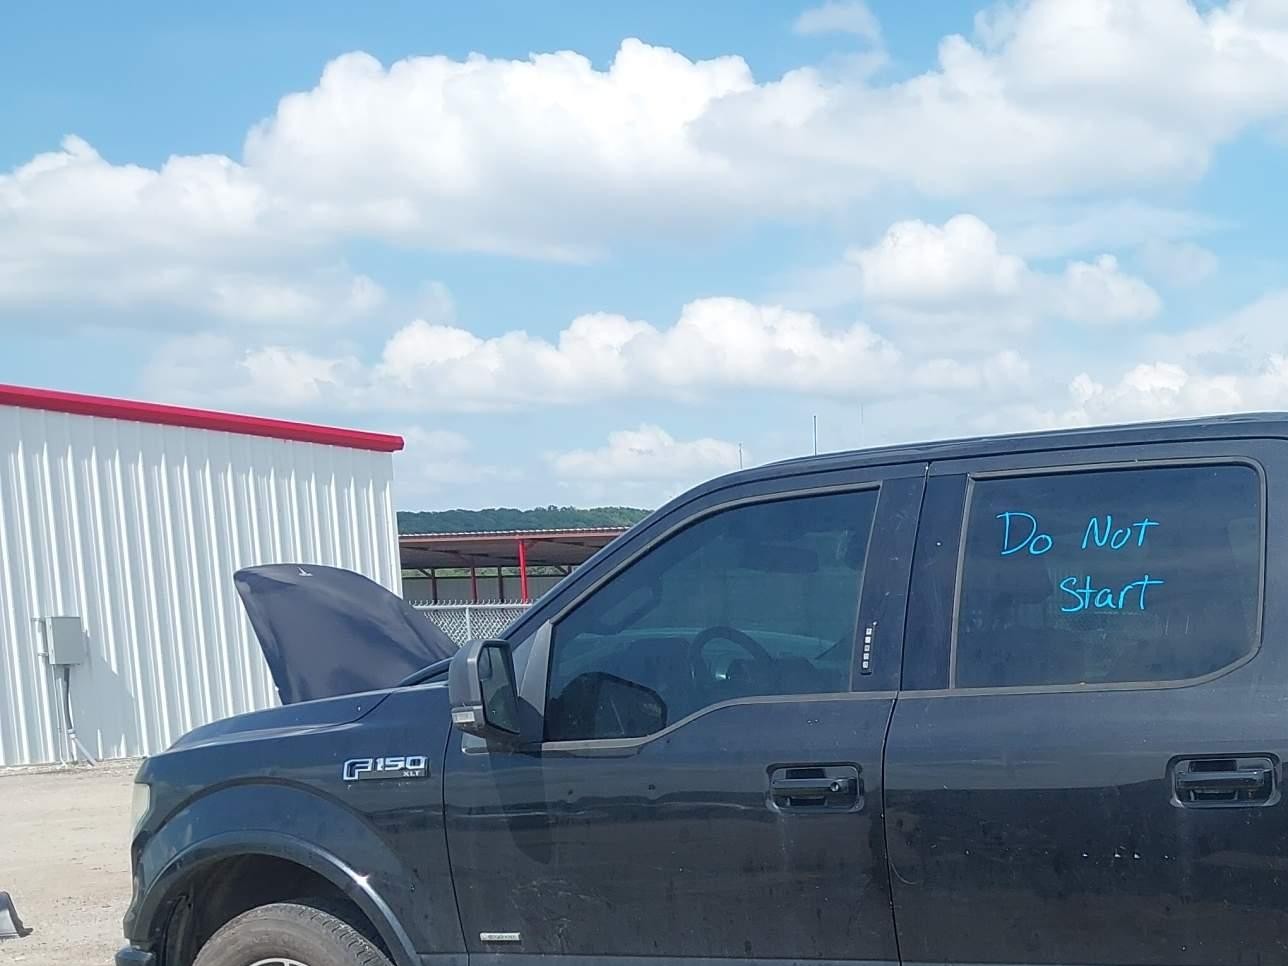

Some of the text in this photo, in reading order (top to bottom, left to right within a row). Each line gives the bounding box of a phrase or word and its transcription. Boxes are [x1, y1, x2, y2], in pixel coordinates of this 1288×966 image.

[996, 511, 1160, 555] Do Not
[1060, 574, 1164, 613] Start
